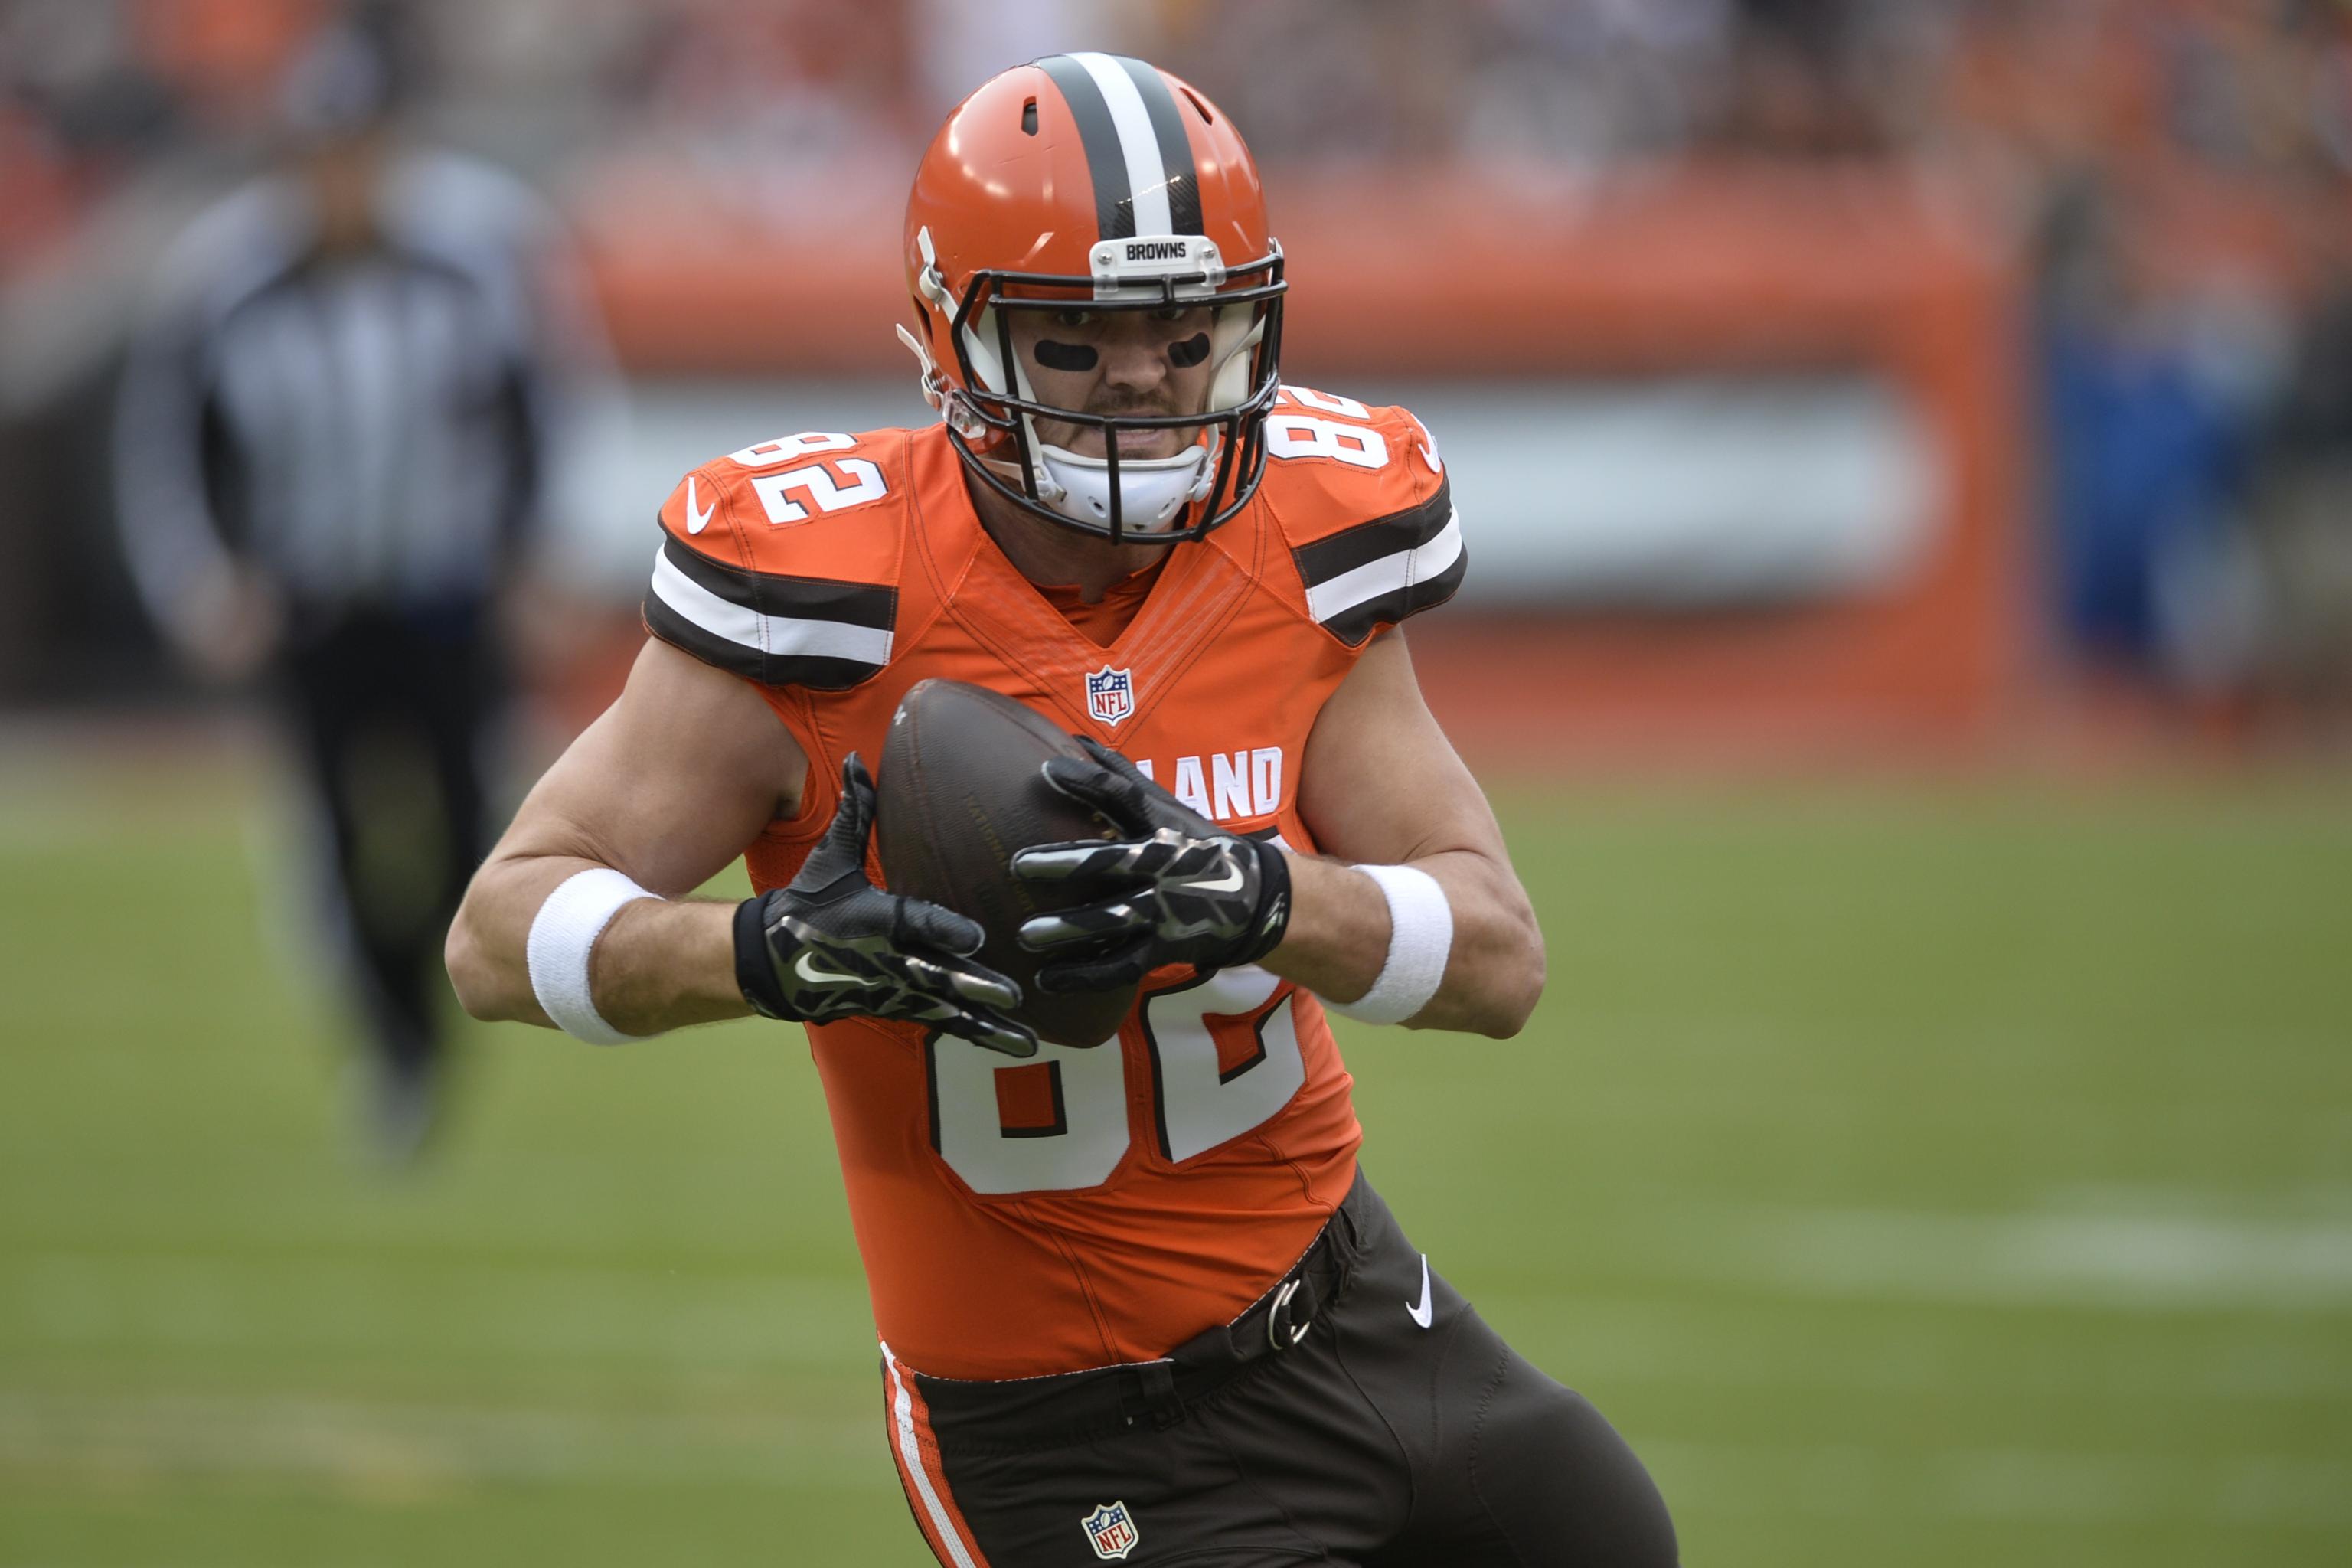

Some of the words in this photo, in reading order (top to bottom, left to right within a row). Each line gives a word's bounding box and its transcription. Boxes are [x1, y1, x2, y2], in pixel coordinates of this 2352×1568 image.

[1126, 242, 1187, 261] BROWNS
[727, 432, 889, 524] 82
[1095, 692, 1127, 715] NFL
[1097, 1524, 1132, 1552] NFL
